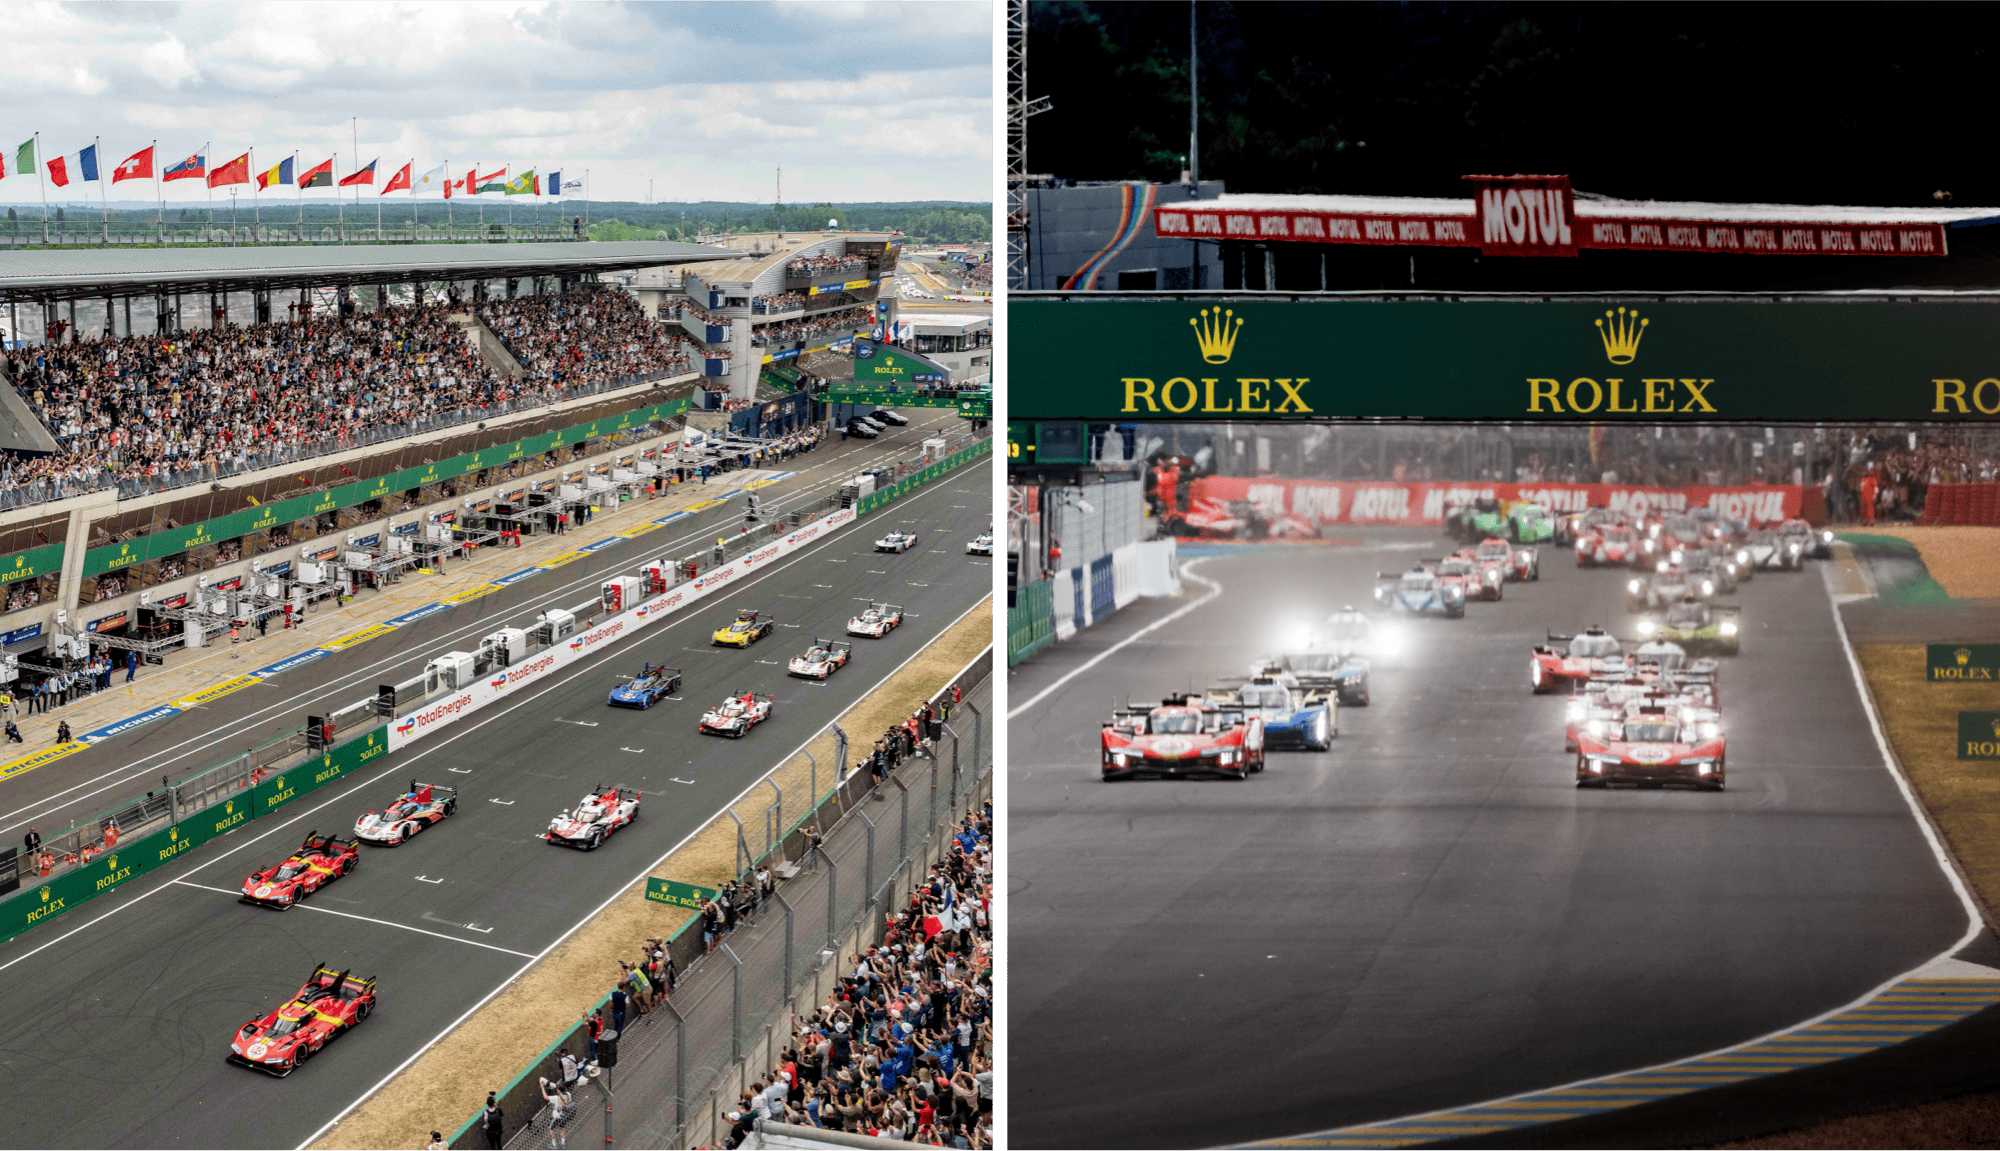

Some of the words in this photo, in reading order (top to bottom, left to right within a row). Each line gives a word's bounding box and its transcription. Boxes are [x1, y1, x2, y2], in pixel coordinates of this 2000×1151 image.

[1483, 189, 1571, 245] MOTUL
[1365, 220, 1394, 240] MOTUL
[1400, 221, 1429, 240] MOTUL
[1435, 221, 1465, 241] MOTUL
[1593, 223, 1626, 244] MOTUL
[1631, 225, 1663, 245] MOTUL
[1668, 226, 1701, 246] MOTUL
[1706, 227, 1739, 248] MOTUL
[1744, 229, 1777, 249] MOTUL
[1783, 230, 1816, 250] MOTUL
[1821, 230, 1855, 250] MOTUL
[1860, 231, 1894, 251] MOTUL
[1900, 232, 1934, 252] MOTUL
[1121, 378, 1313, 412] ROLEX
[1527, 378, 1717, 412] ROLEX
[1933, 379, 2000, 413] RO
[421, 472, 438, 483] ROLEX
[371, 485, 390, 499] ROLEX
[316, 500, 335, 511] ROLEX
[1351, 488, 1409, 520] MOTUL
[254, 515, 276, 530] ROLEX
[186, 533, 210, 547] ROLEX
[109, 553, 136, 567] ROLEX
[752, 546, 779, 563] TotalEnergies
[2, 565, 33, 582] ROLEX
[704, 568, 734, 588] TotalEnergies
[404, 605, 444, 622] MICHELIN
[649, 591, 682, 616] TotalEnergies
[342, 626, 388, 644] MICHELIN
[582, 621, 624, 646] TotalEnergies
[272, 650, 325, 671] MICHELIN
[506, 654, 554, 684] TotalEnergies
[1934, 667, 1991, 679] ROLEX
[196, 678, 252, 701] MICHELIN
[106, 708, 172, 735] MICHELIN
[416, 694, 472, 728] TotalEnergies
[4, 744, 79, 774] MICHELIN
[361, 742, 382, 761] ROLEX
[317, 762, 340, 782] ROLEX
[269, 785, 294, 806] ROLEX
[216, 810, 243, 831] ROLEX
[160, 836, 189, 859] ROLEX
[97, 864, 130, 889] ROLEX
[649, 892, 677, 903] ROLEX
[681, 898, 701, 908] ROL
